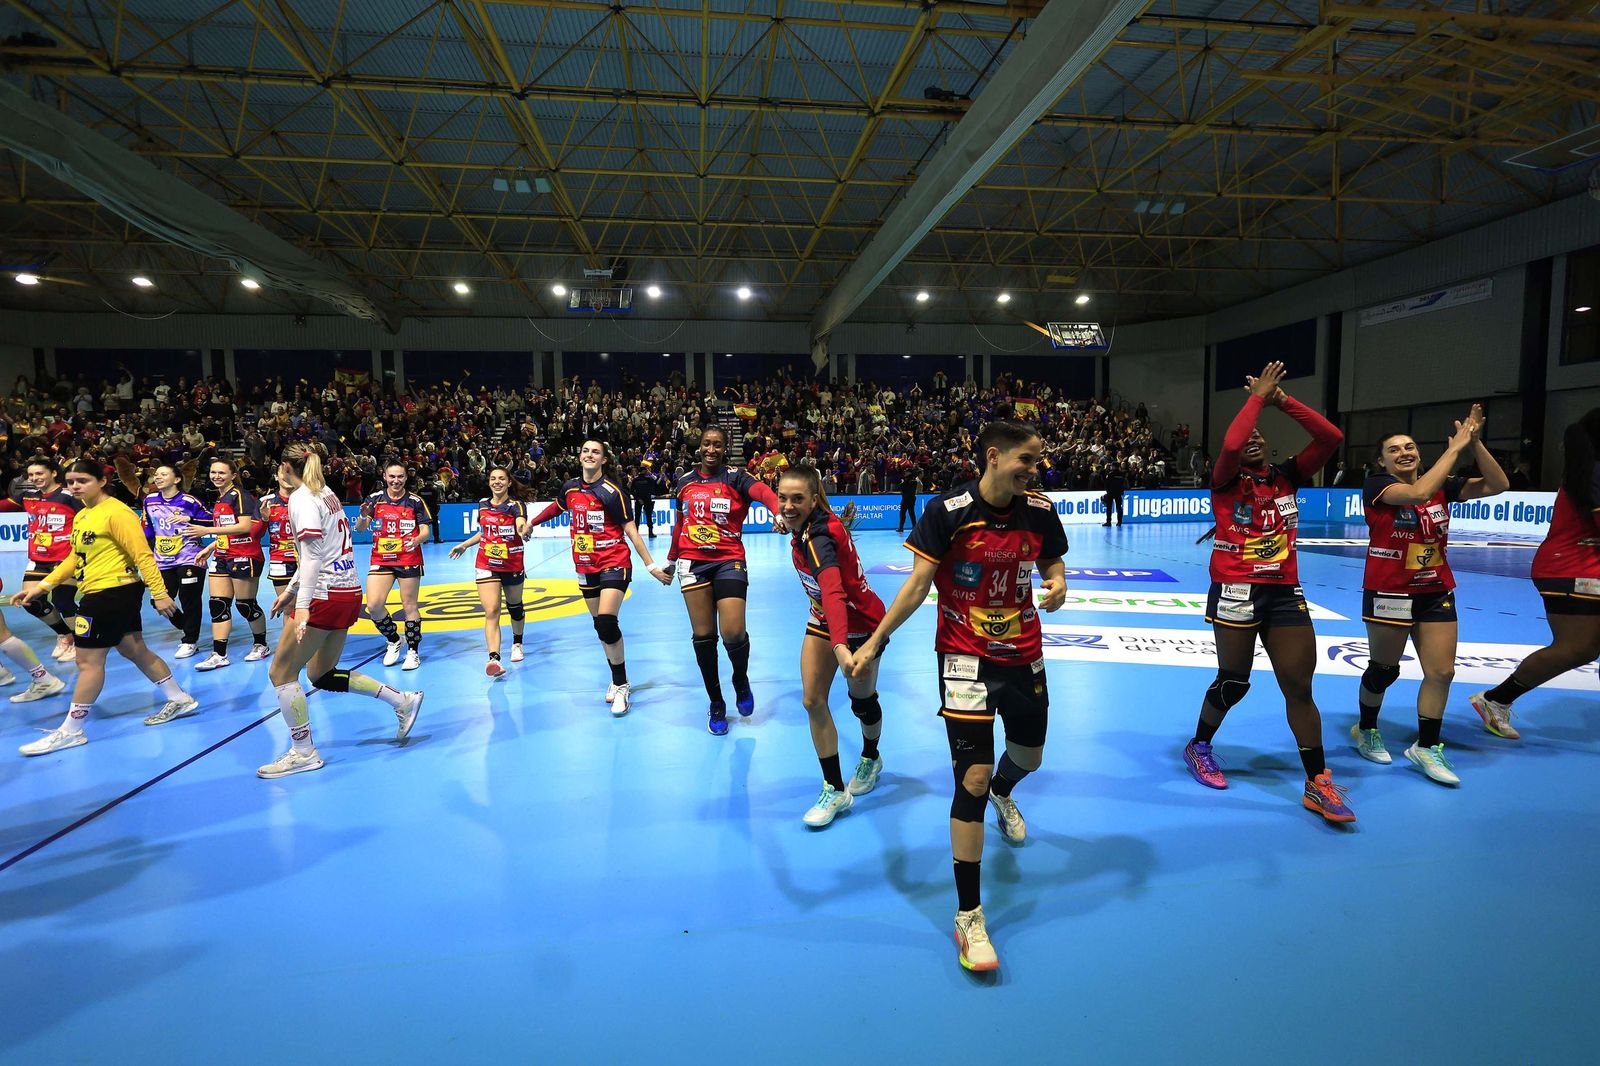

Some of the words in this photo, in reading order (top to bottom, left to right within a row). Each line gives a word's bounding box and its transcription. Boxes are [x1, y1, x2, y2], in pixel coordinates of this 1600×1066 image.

[694, 501, 705, 518] 33
[863, 504, 902, 512] MUNICIPIOS
[1077, 499, 1089, 514] el
[1132, 496, 1211, 517] jugamos
[1494, 501, 1509, 521] el
[576, 513, 585, 528] 19
[1261, 509, 1276, 529] 27
[387, 521, 397, 534] 58
[485, 525, 499, 537] 75
[1228, 524, 1250, 535] AVIS
[1390, 531, 1415, 540] AVIS
[988, 569, 1010, 599] 34
[952, 589, 976, 601] AVIS
